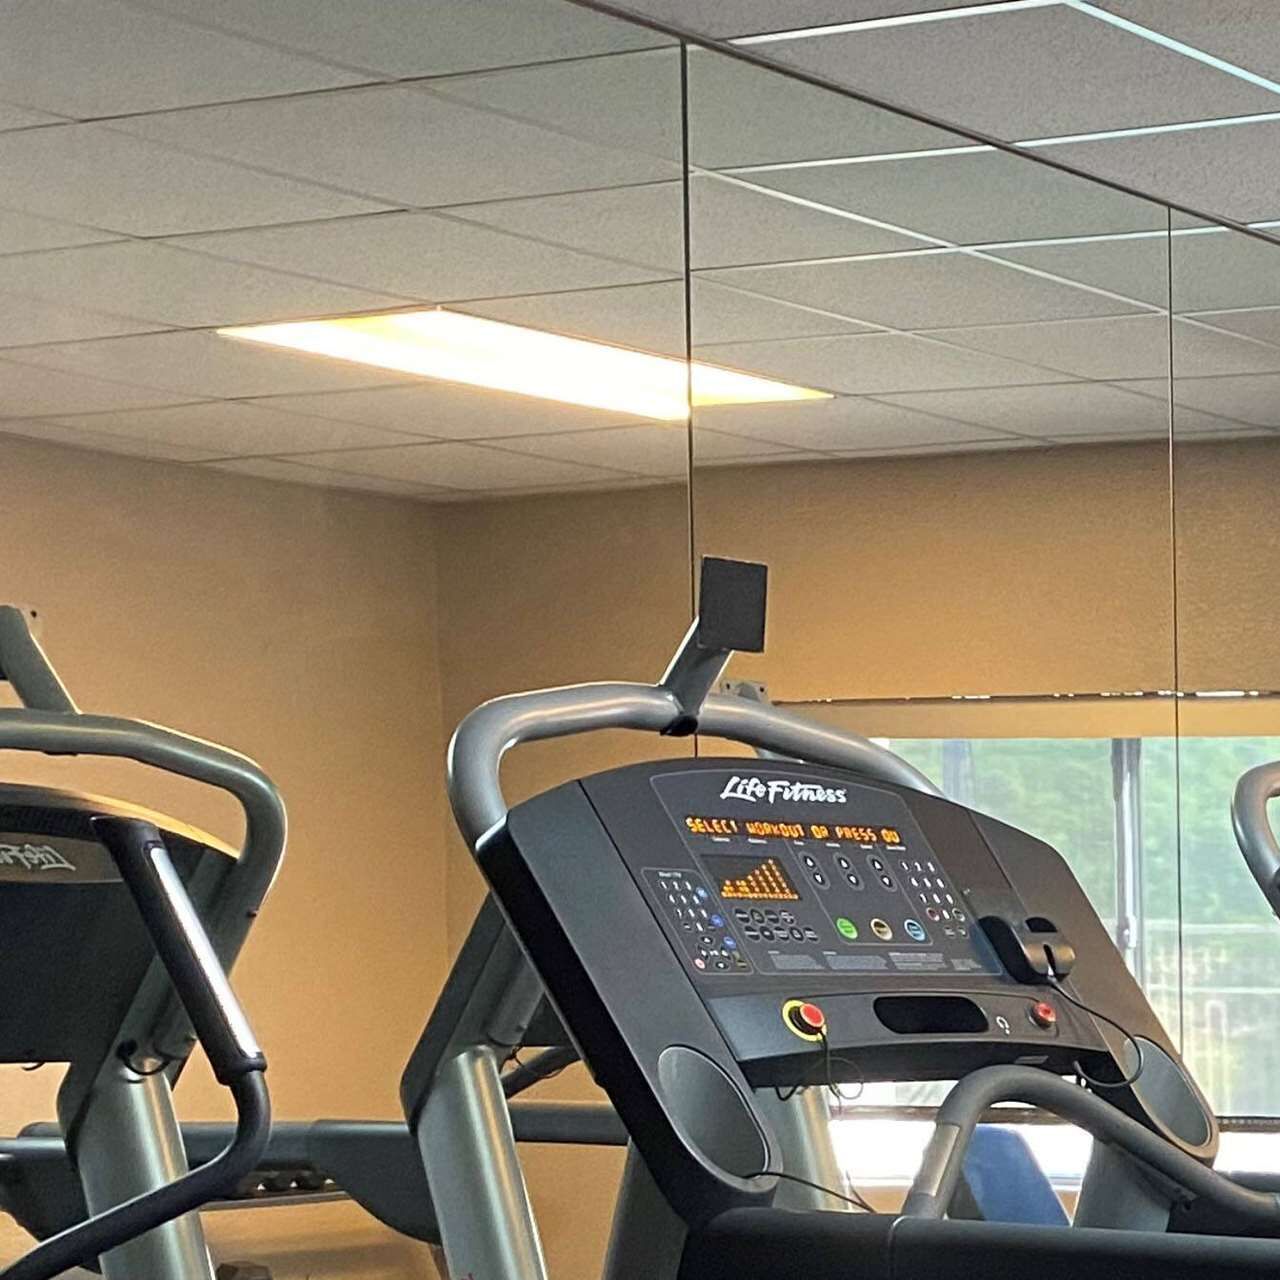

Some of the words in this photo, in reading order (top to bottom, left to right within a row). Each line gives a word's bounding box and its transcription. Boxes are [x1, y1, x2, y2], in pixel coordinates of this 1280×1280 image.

[685, 816, 738, 834] SELECT
[745, 820, 806, 838] WORKOUT
[810, 824, 829, 839] OR
[834, 826, 878, 842] PRESS
